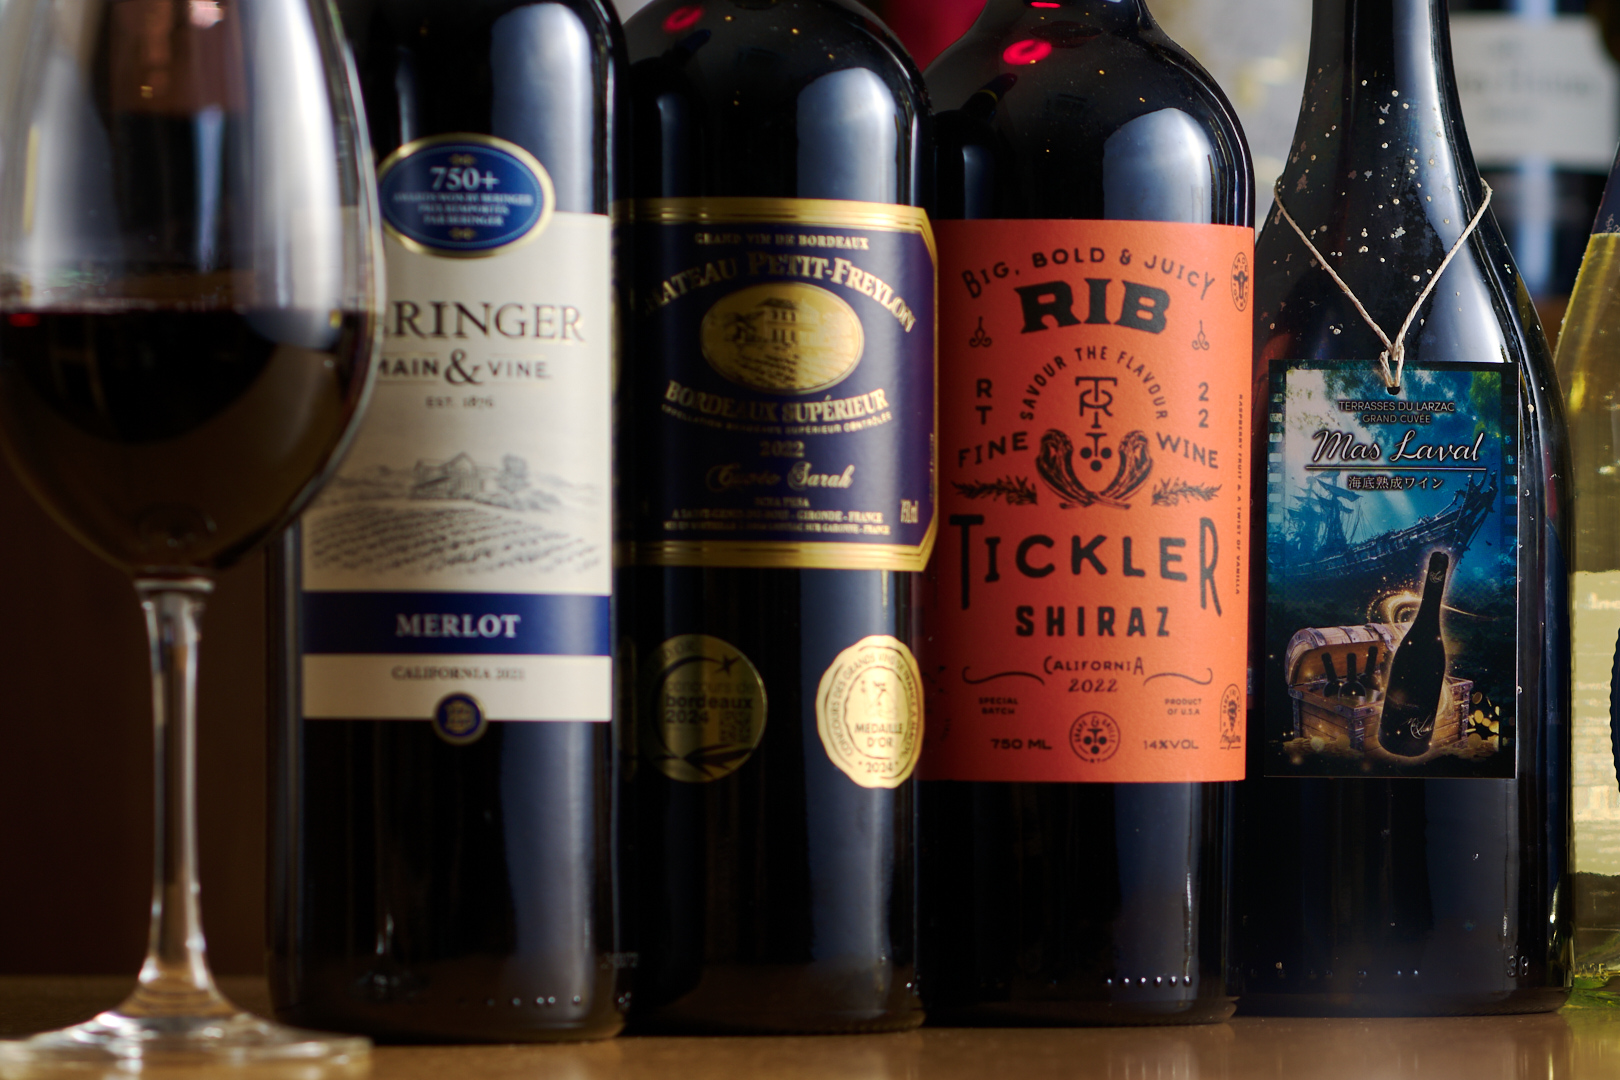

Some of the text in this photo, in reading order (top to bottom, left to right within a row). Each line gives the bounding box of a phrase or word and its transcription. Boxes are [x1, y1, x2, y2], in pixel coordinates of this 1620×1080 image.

[431, 167, 500, 191] 750+
[798, 234, 869, 251] BORDEAUX
[1032, 247, 1105, 268] BOLD
[1119, 248, 1132, 265] &
[1144, 255, 1215, 301] JUICY
[1014, 277, 1170, 335] RIB
[444, 348, 484, 386] &
[1019, 346, 1168, 421] SAVOUR THE FLAVOUR
[664, 379, 890, 424] BORDEAUX SUPÉRIEUR
[1339, 401, 1455, 412] TERRASSES DU LARZAC
[1362, 412, 1431, 423] GRAND CUVÉE
[958, 431, 1029, 468] FINE
[1155, 431, 1219, 469] WINE
[1312, 429, 1485, 462] Mas Laval
[787, 460, 856, 492] Sarah
[1348, 475, 1444, 490] 海底熟成ワイン
[949, 514, 1222, 617] TICKLER
[396, 614, 521, 639] MERLOT
[1016, 606, 1170, 637] SHIRAZ
[1044, 656, 1144, 676] CALIFORNIA
[1068, 678, 1118, 693] 2022
[1165, 698, 1202, 706] PRODUCT
[1167, 708, 1178, 716] OF
[990, 739, 1053, 750] 750 ML
[865, 762, 893, 773] 2024
